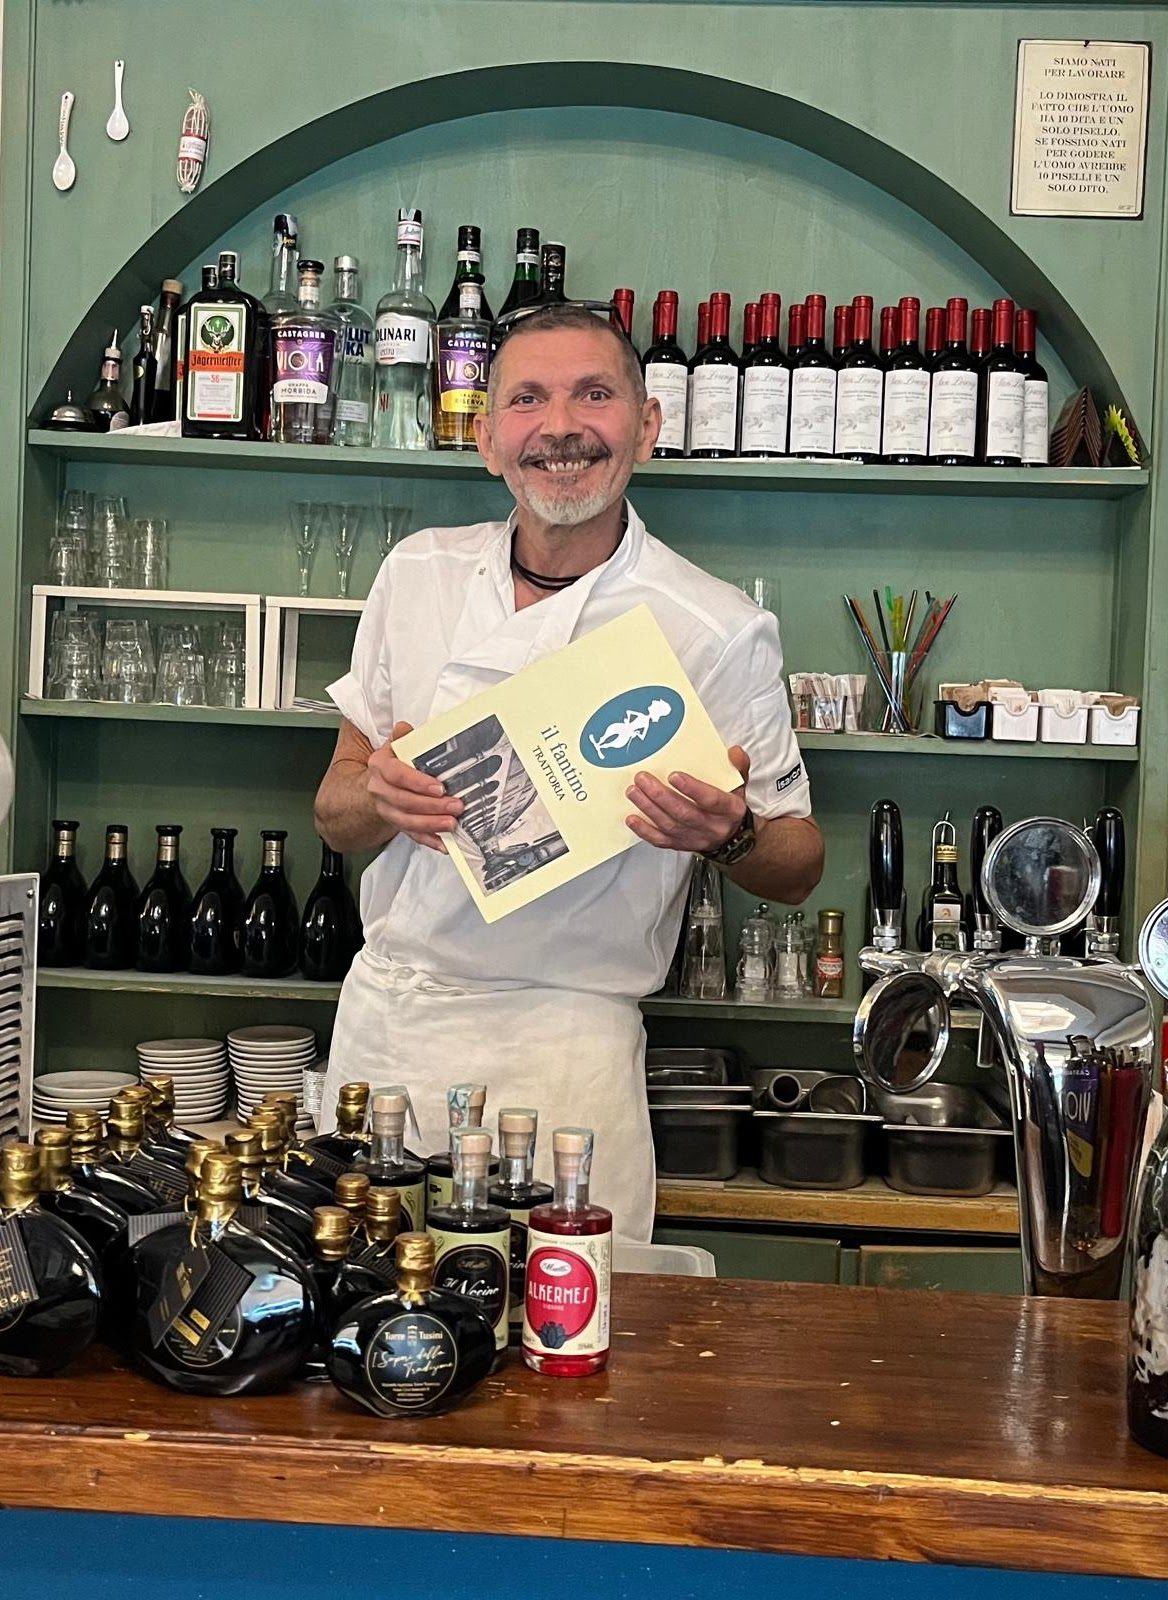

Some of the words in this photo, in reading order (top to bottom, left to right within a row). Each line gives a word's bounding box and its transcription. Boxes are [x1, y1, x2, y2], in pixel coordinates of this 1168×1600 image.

[1053, 58, 1088, 66] SIAMO
[1090, 58, 1117, 67] NATI
[1044, 69, 1065, 78] PER
[1068, 69, 1126, 79] LAVORARE
[1039, 91, 1054, 100] LO
[1056, 91, 1113, 102] DIMOSTRA
[1116, 93, 1128, 102] IL
[1031, 103, 1065, 112] FATTO
[1067, 103, 1090, 113] CHE
[1091, 104, 1134, 114] L'UOMO
[1040, 114, 1055, 123] HA
[1058, 115, 1068, 123] 10
[1070, 115, 1096, 124] DITA
[1099, 116, 1106, 125] E
[1108, 116, 1124, 125] UN
[1041, 126, 1070, 135] SOLO
[1034, 137, 1049, 146] SE
[1050, 138, 1098, 147] FOSSIMO
[1101, 139, 1127, 149] NATI
[1046, 149, 1068, 158] PER
[1069, 150, 1116, 160] GODERE
[1033, 160, 1076, 170] L'UOMO
[1078, 162, 1127, 171] AVREBBE
[1038, 173, 1049, 181] 10
[1051, 173, 1094, 182] PISELLI
[1095, 174, 1102, 182] E
[1104, 174, 1121, 183] UN
[1047, 184, 1076, 192] SOLO
[277, 330, 326, 339] CASTAGNER
[375, 327, 416, 342] OLINARI
[276, 350, 325, 373] VIOLA
[540, 725, 560, 741] il
[550, 742, 588, 801] fantino
[532, 745, 566, 801] TRATTORIA
[528, 1280, 591, 1305] ALKERMES
